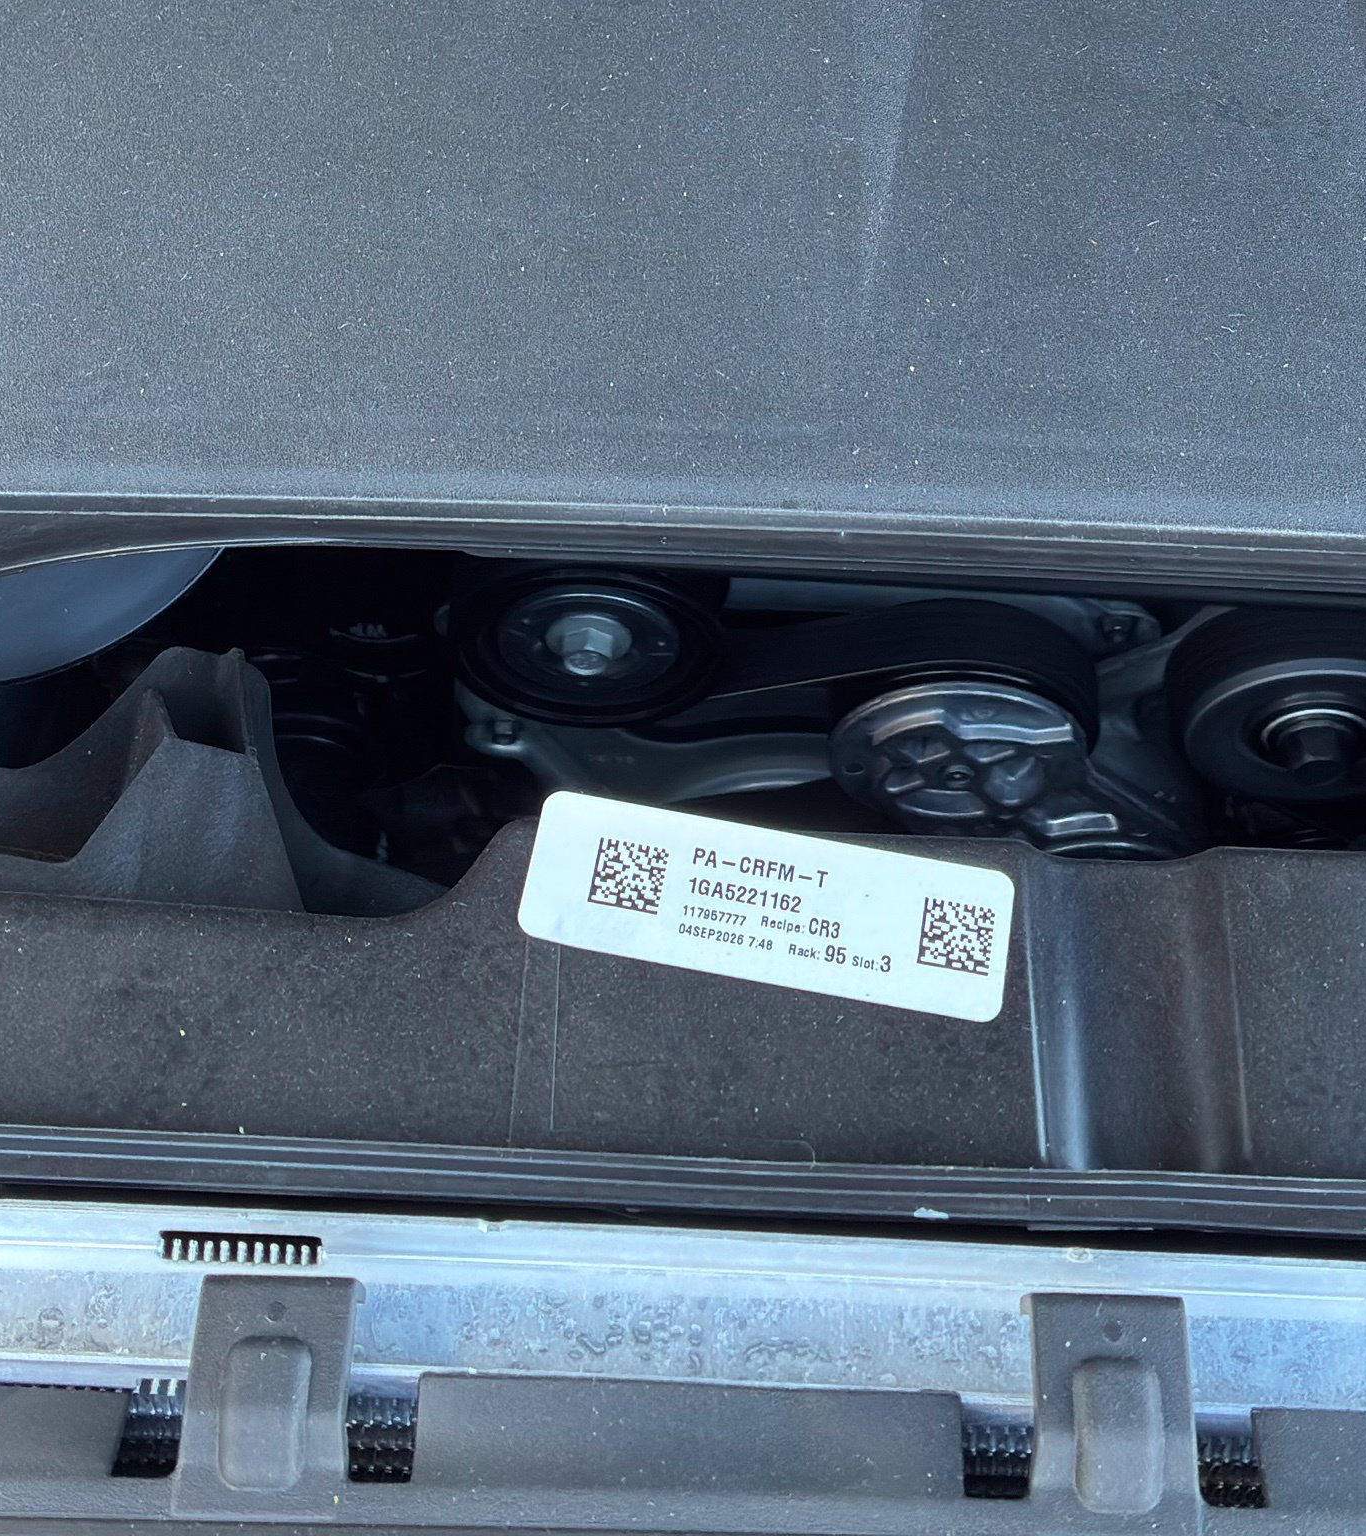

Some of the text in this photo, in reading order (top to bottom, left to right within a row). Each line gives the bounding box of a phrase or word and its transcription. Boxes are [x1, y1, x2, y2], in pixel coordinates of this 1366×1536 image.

[689, 876, 802, 913] 1GA5221162
[678, 923, 744, 946] 04SEP2026
[748, 936, 773, 951] 7:48
[788, 944, 821, 960] Rack:
[823, 944, 847, 965] 95
[761, 916, 805, 934] Recipe:
[808, 917, 841, 939] CR3
